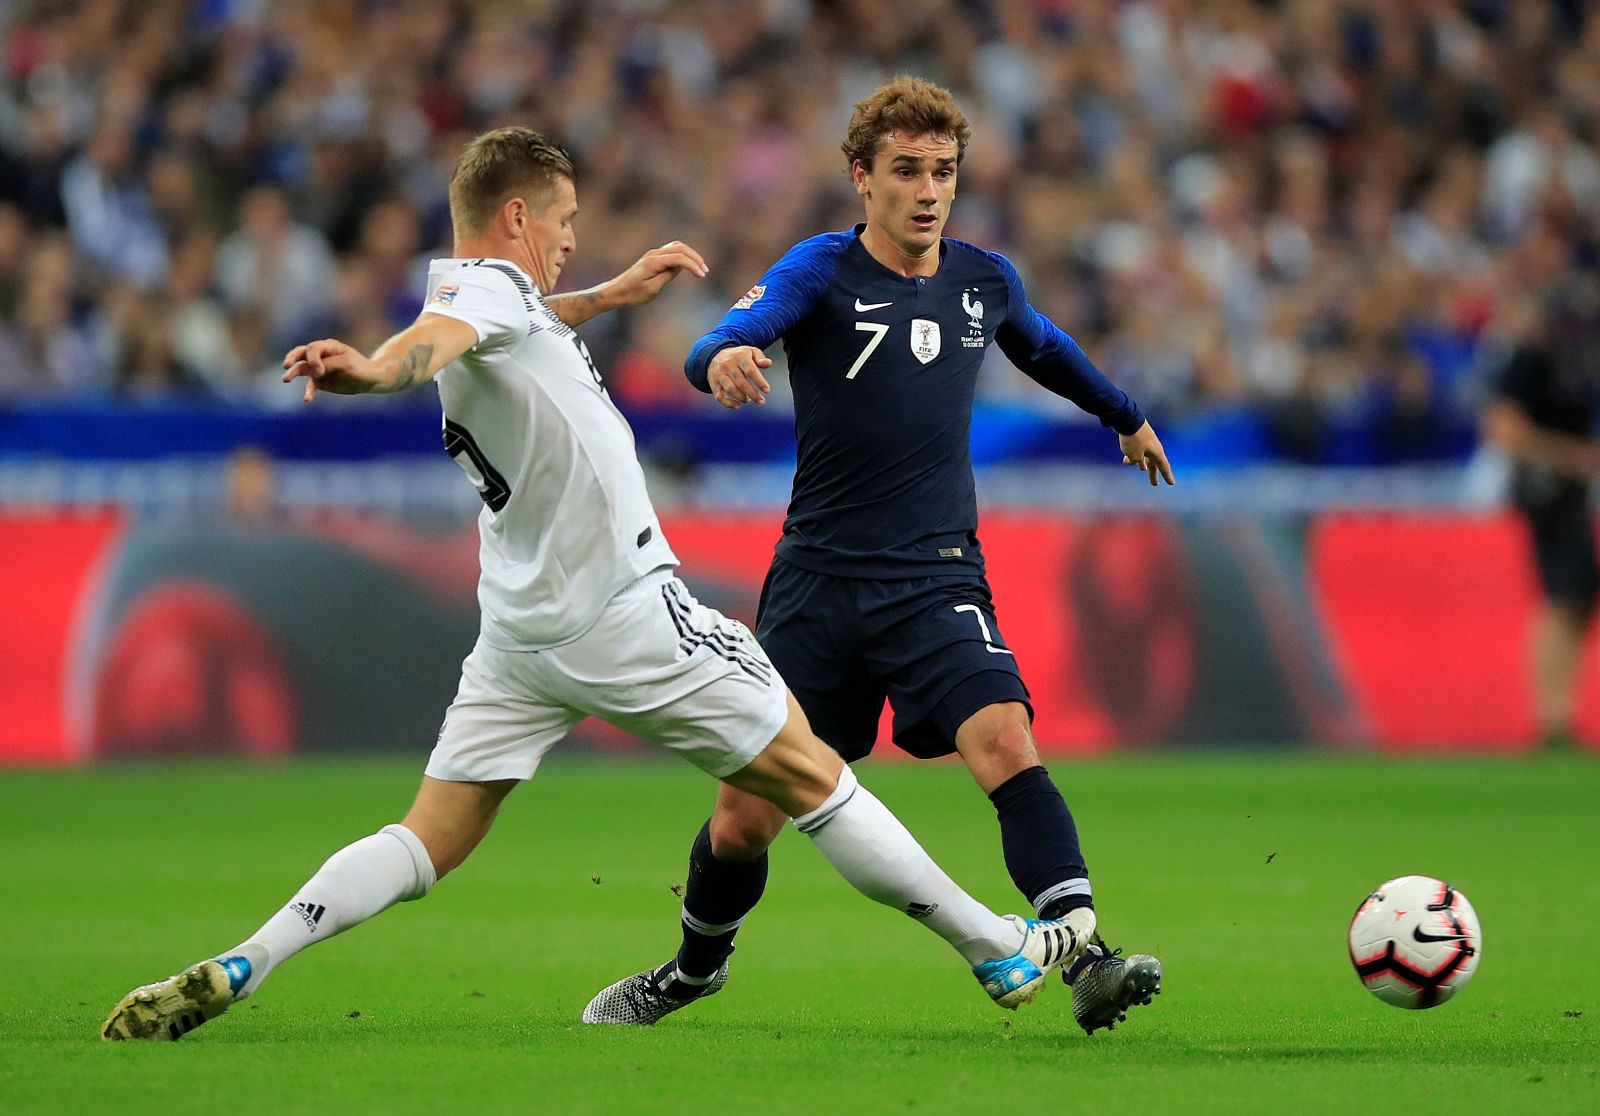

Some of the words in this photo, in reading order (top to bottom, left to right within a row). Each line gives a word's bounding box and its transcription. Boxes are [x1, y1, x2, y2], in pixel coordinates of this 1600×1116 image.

[845, 321, 890, 380] 7
[953, 604, 993, 643] 7
[290, 904, 317, 933] adidas
